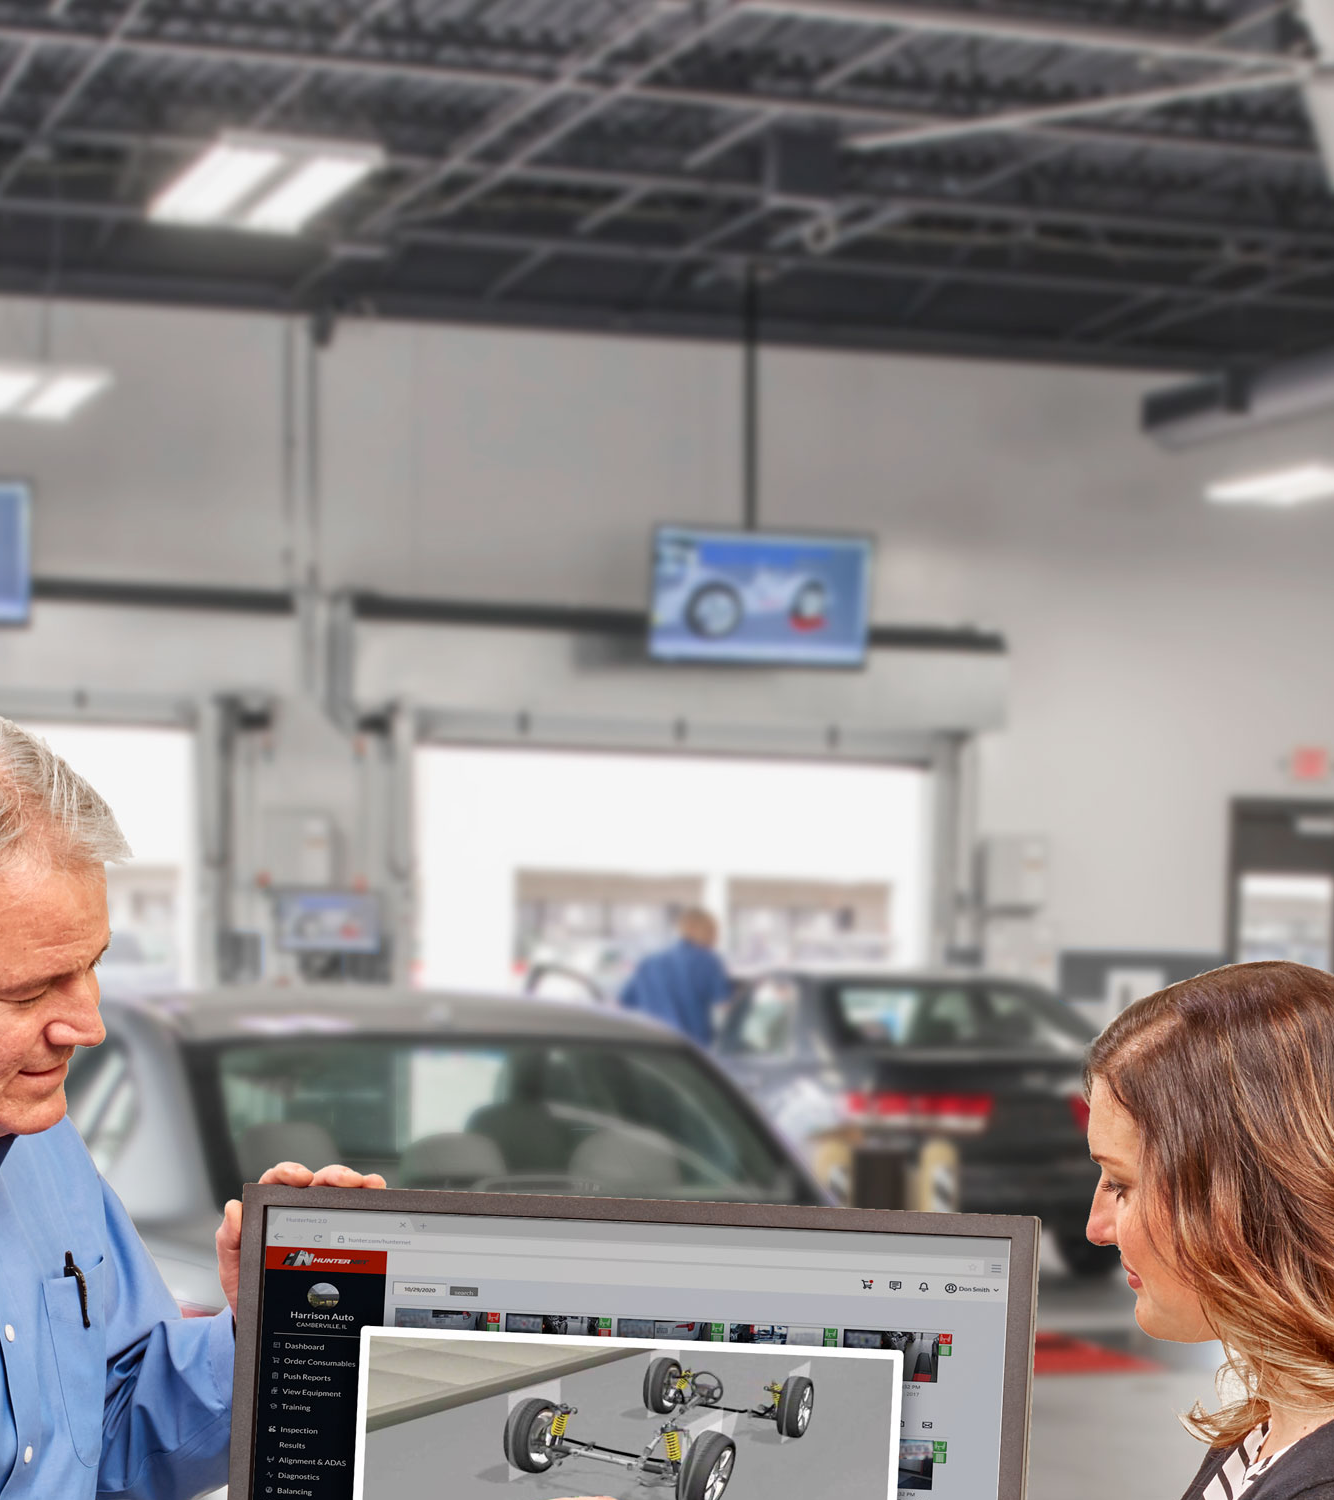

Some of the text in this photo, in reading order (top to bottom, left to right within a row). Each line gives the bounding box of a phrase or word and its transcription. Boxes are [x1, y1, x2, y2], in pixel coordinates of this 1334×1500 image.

[290, 1311, 355, 1322] Harrison Auto
[284, 1342, 325, 1351] Dashboard
[284, 1357, 356, 1368] Order Consumables
[283, 1372, 331, 1382] Push Reports
[282, 1388, 342, 1398] View Equipment
[281, 1403, 311, 1412] Training
[280, 1426, 318, 1435] Inspection
[279, 1441, 306, 1450] Results
[278, 1457, 316, 1466] Alignment
[324, 1459, 347, 1467] ADAS
[277, 1472, 320, 1481] Diagnostics
[277, 1487, 313, 1497] Balancing
